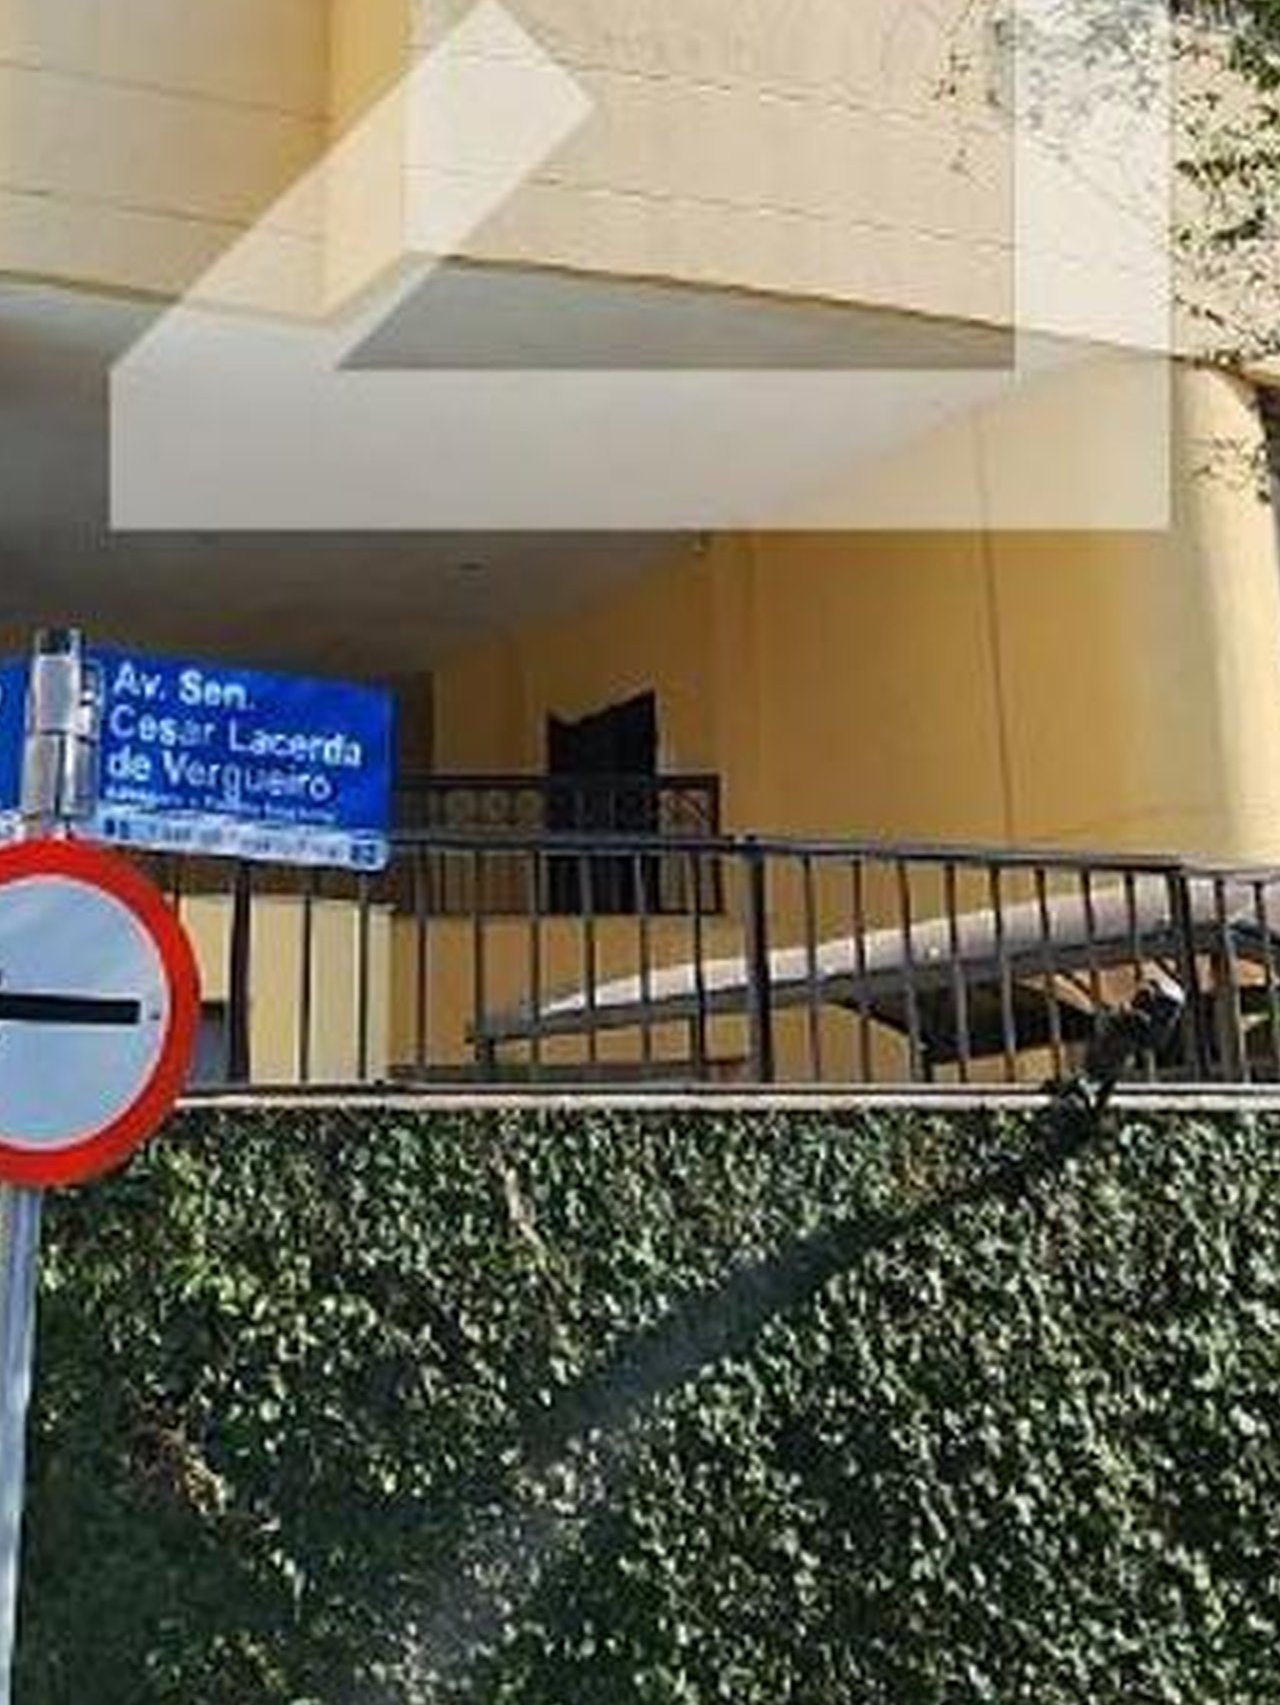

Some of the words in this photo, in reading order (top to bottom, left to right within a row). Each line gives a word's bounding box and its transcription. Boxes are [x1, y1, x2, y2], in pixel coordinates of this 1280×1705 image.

[113, 660, 167, 701] Av.
[177, 668, 256, 711] Sen.
[109, 704, 217, 747] Cesar
[228, 716, 362, 768] Lacerda
[106, 743, 152, 782] de
[162, 750, 333, 805] Vergueiro
